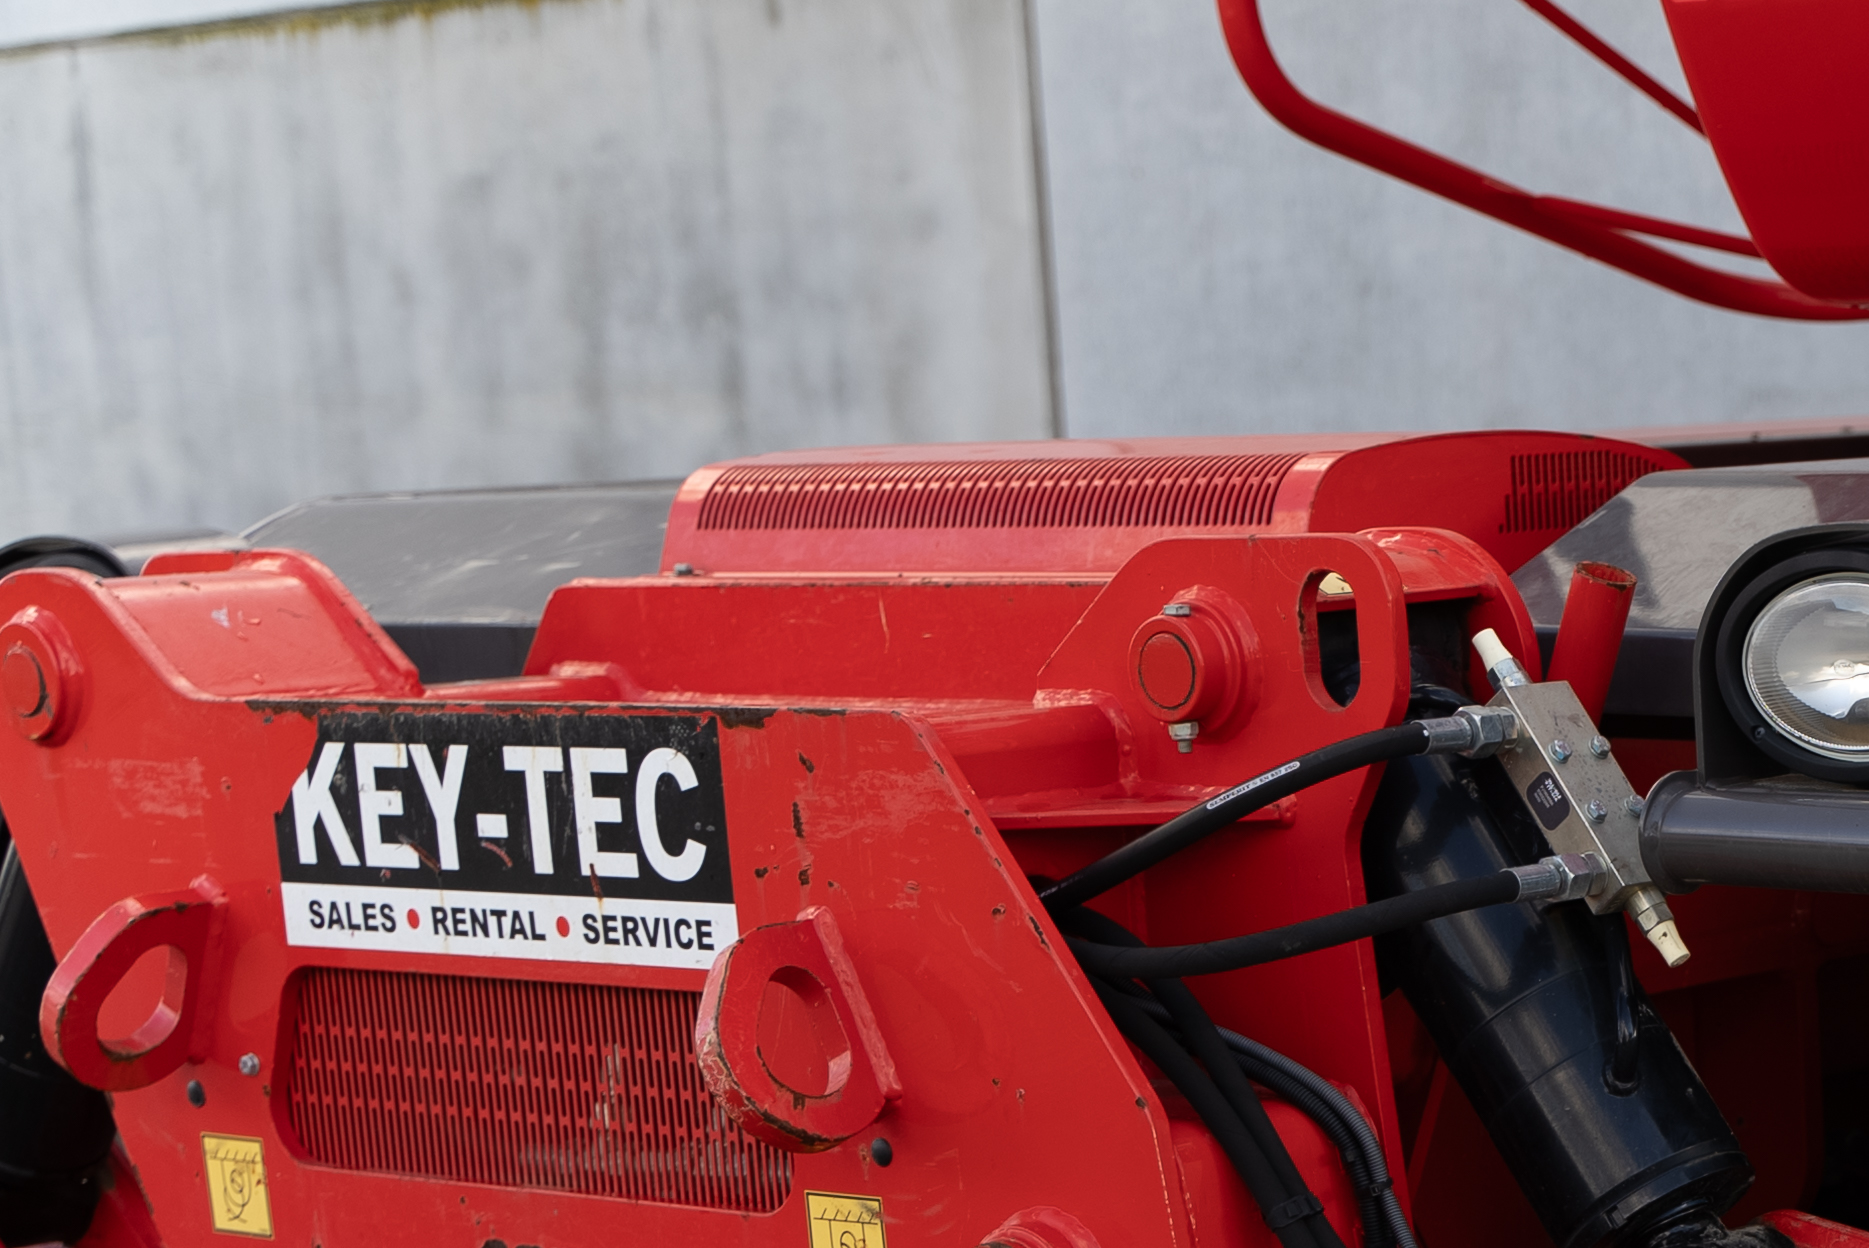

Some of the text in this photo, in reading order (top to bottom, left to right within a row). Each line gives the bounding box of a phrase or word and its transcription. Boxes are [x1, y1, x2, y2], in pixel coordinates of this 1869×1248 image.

[292, 741, 706, 882] KEY-TEC
[308, 899, 715, 951] SALES RENTAL SERVICE
